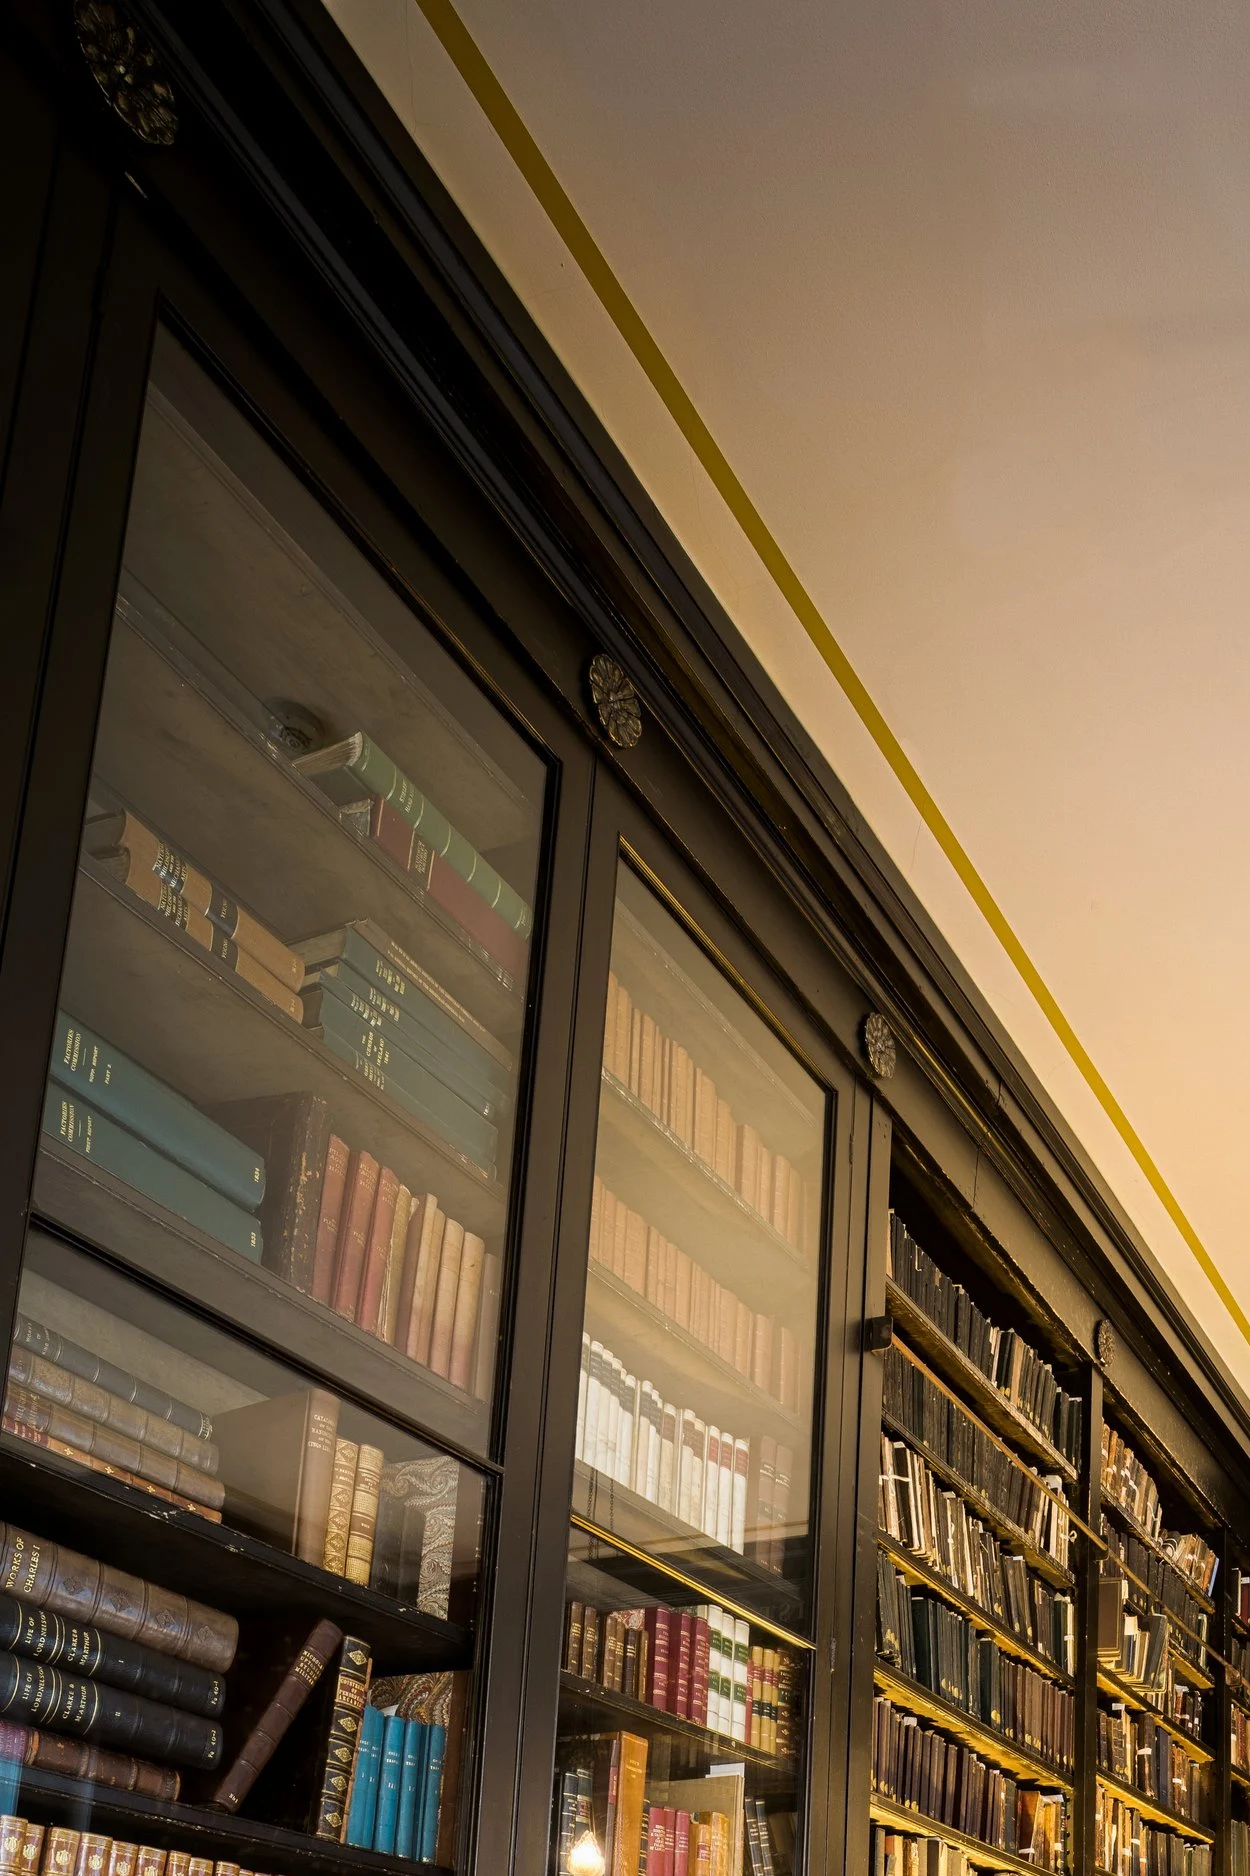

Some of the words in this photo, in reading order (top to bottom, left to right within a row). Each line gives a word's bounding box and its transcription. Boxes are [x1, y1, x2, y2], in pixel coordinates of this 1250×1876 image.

[63, 1028, 74, 1064] FACTORIES
[70, 1032, 82, 1072] COMMISSION
[365, 1031, 374, 1057] CENSUS
[67, 1104, 75, 1142] COMMISSION
[6, 1552, 22, 1589] WORKS
[16, 1536, 25, 1551] OF
[23, 1552, 40, 1593] CHARLES
[25, 1627, 33, 1644] LIFE
[67, 1633, 77, 1662] CLARKE
[22, 1684, 31, 1700] LIFE
[62, 1691, 74, 1719] CLARKE
